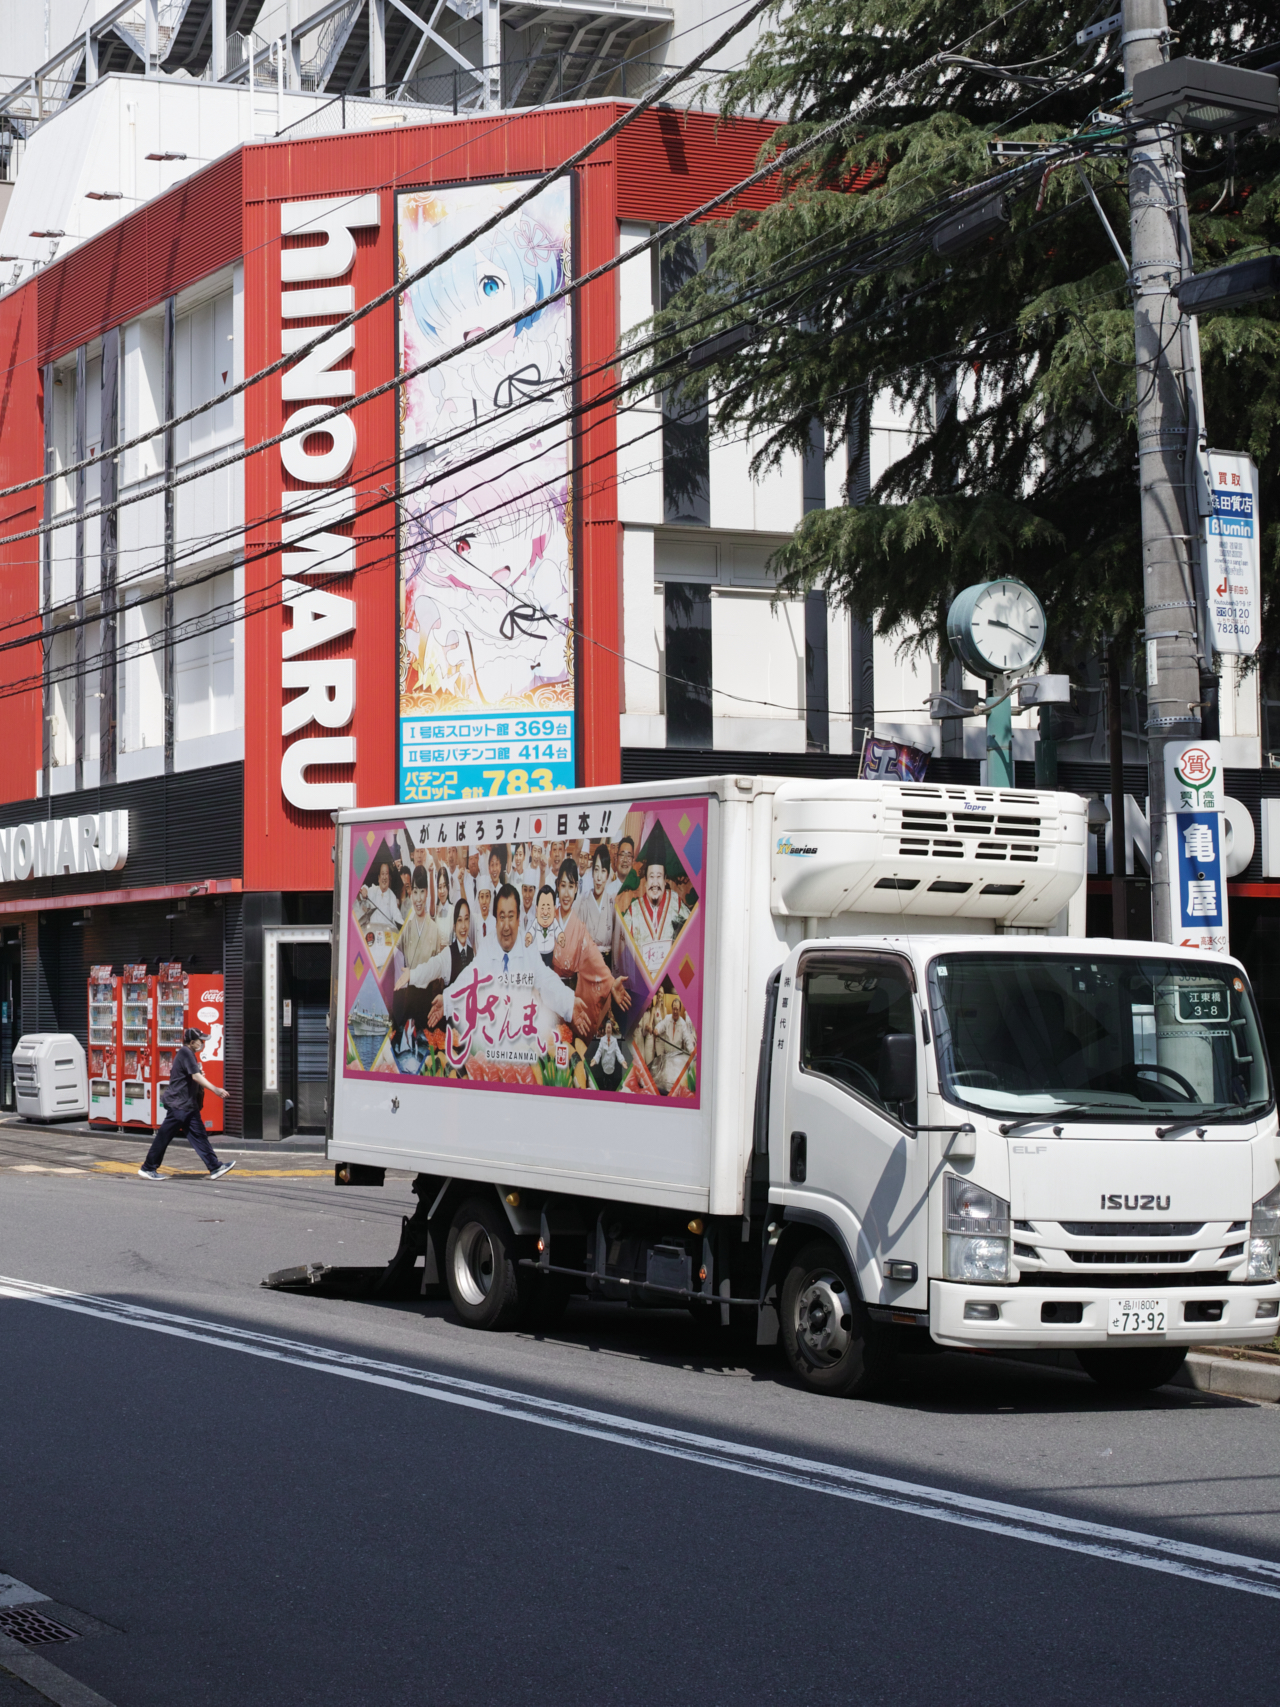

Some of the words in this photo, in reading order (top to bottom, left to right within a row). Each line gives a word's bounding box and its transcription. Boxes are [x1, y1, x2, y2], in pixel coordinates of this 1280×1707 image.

[1218, 471, 1241, 487] 買取
[1227, 608, 1250, 619] 0120
[1217, 623, 1250, 635] 782840
[1187, 754, 1205, 775] 質
[405, 771, 459, 786] パチンコ
[405, 785, 456, 800] スロット
[1180, 791, 1193, 809] 買入
[1203, 790, 1215, 808] 高価
[964, 802, 987, 811] Topre
[1183, 823, 1217, 917] 亀屋
[1189, 992, 1222, 1003] 江東橋
[1194, 1006, 1218, 1016] 3-8
[486, 1050, 537, 1061] SUSHIZANMAI
[1012, 1145, 1048, 1155] ELF
[1101, 1193, 1172, 1211] ISUZU
[1122, 1312, 1165, 1332] 73-92
